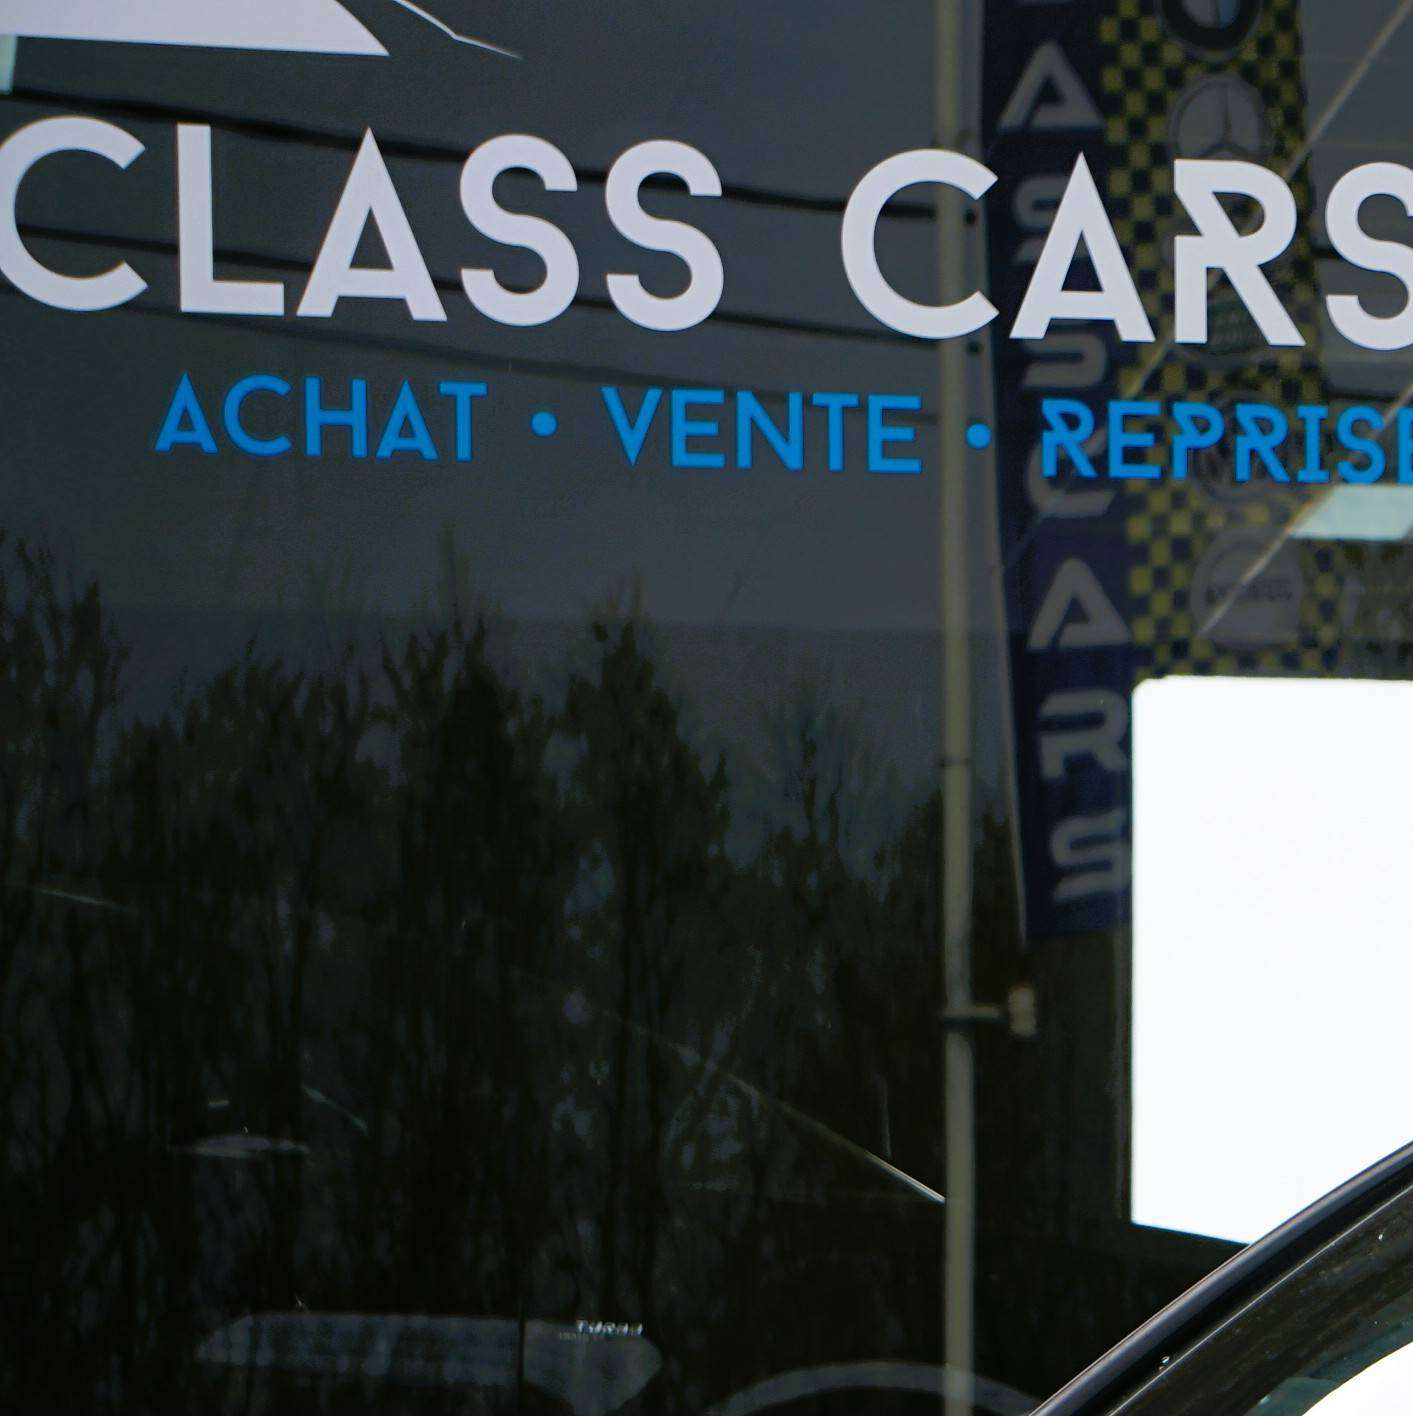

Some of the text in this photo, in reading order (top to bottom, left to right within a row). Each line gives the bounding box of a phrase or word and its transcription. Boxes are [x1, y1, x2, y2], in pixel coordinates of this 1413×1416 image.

[0, 116, 724, 331] CLASS
[154, 373, 487, 462] ACHAT
[601, 386, 922, 473] VENTE
